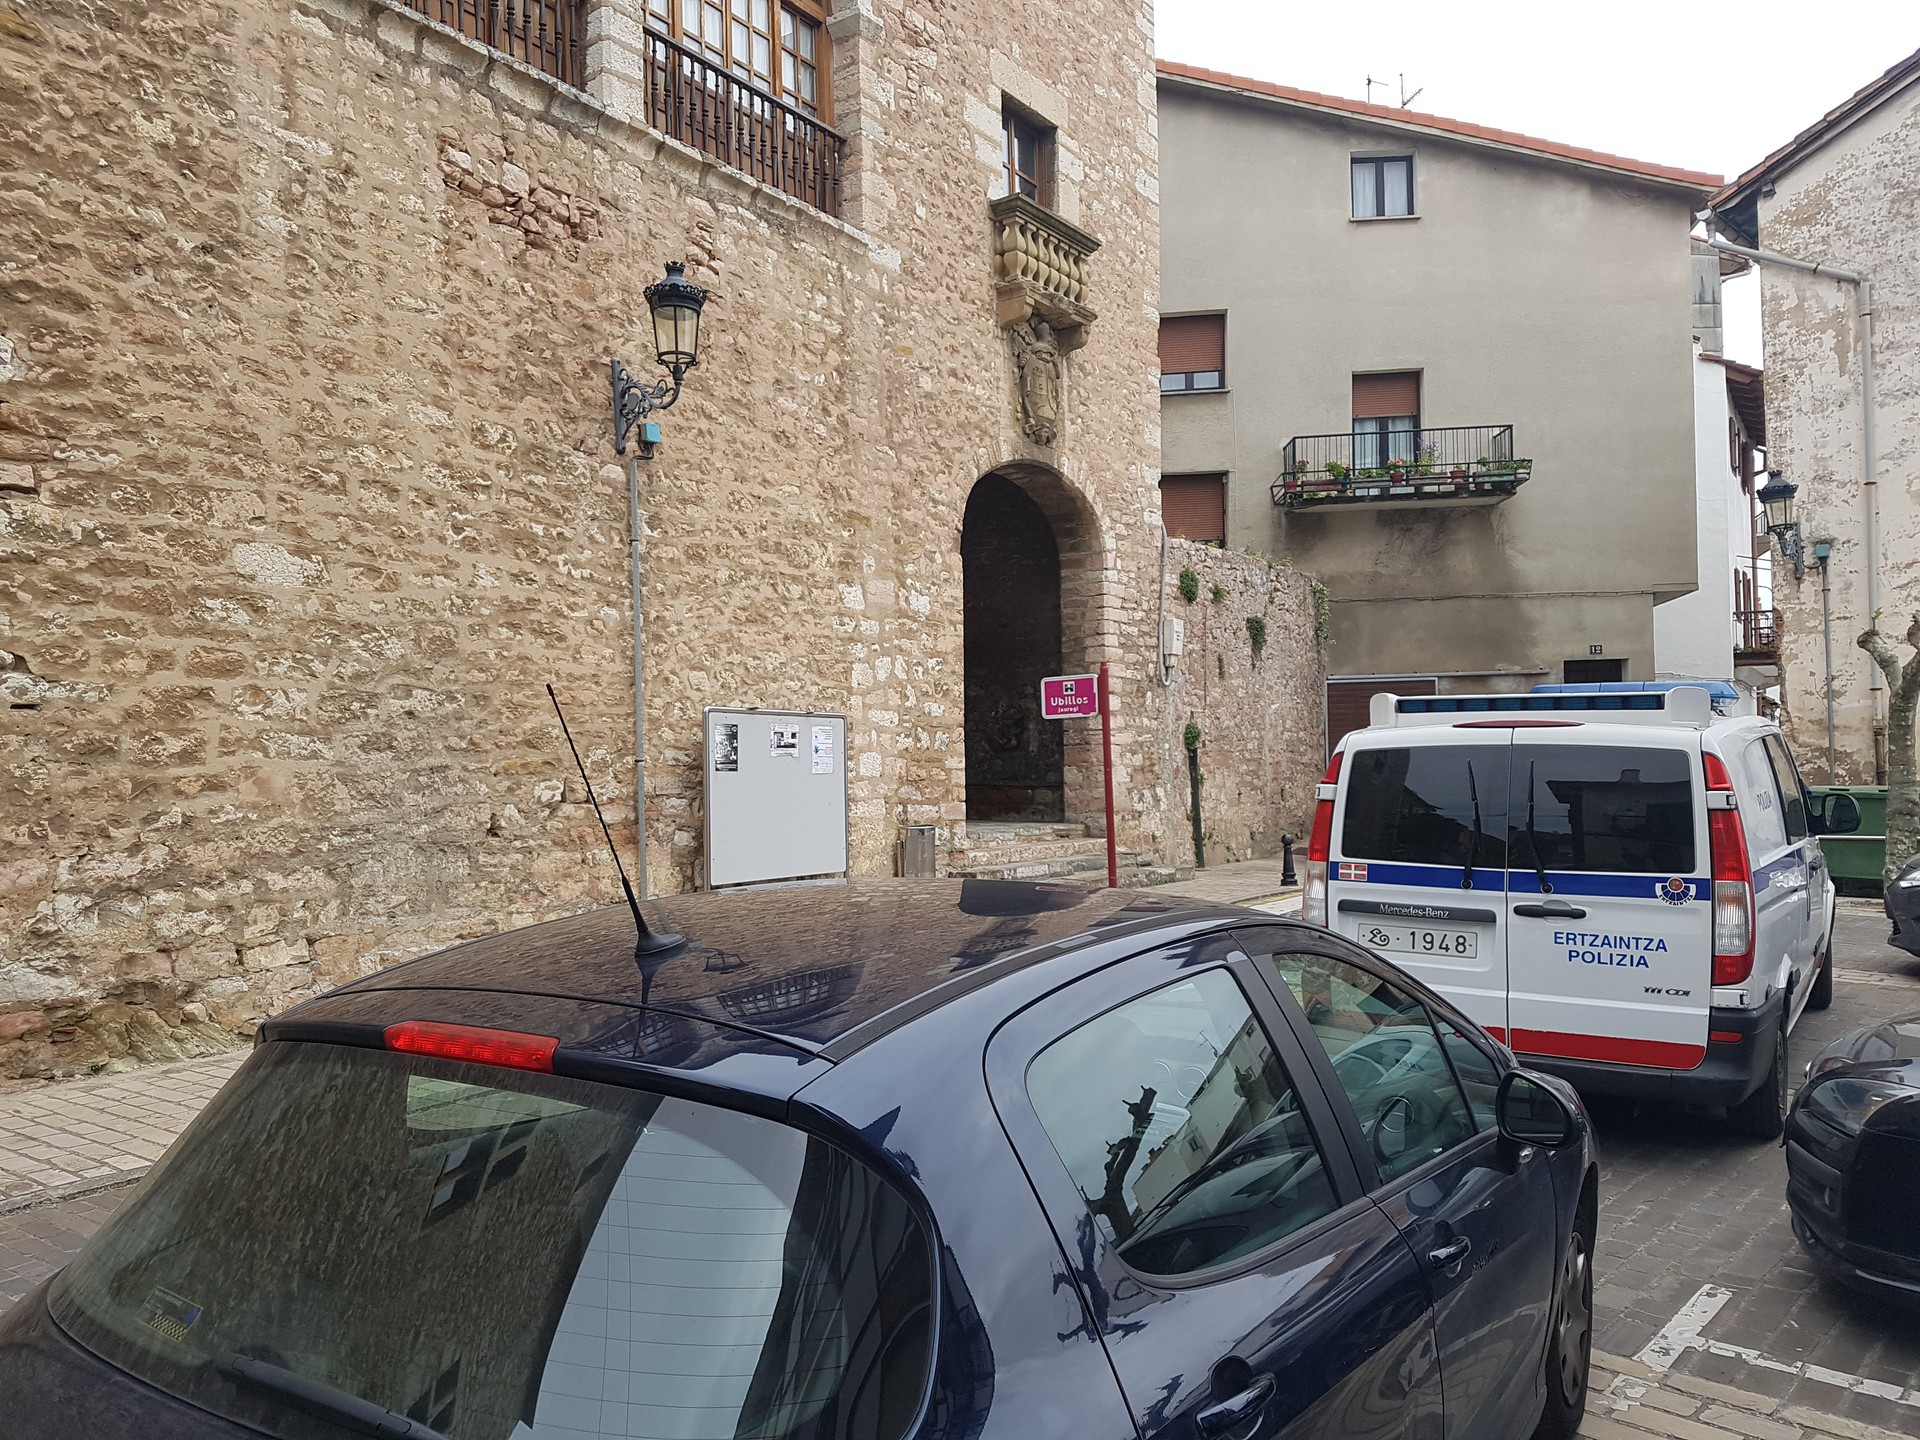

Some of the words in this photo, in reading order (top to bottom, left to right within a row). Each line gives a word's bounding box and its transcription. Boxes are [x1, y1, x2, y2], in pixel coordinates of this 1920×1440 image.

[1050, 695, 1089, 706] Ubillos
[1379, 904, 1450, 919] Mercedes-Benz
[1409, 930, 1467, 954] 1948
[1553, 931, 1668, 953] ERTZAINTZA
[1568, 949, 1650, 969] POLIZIA
